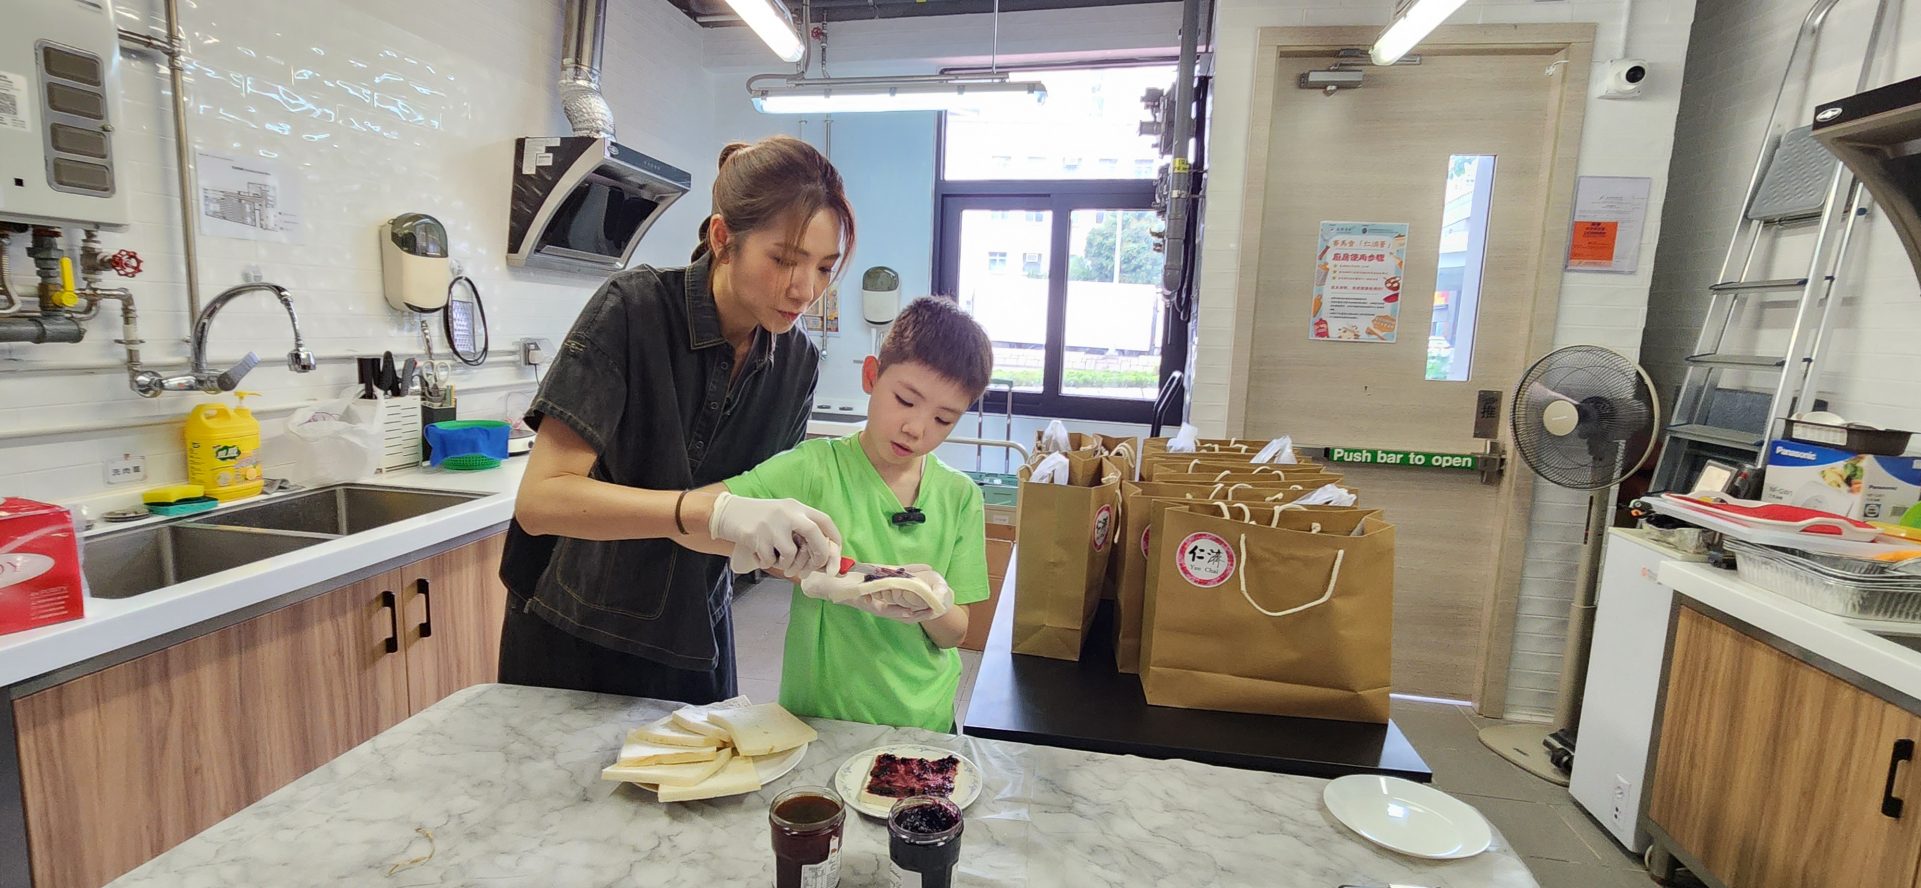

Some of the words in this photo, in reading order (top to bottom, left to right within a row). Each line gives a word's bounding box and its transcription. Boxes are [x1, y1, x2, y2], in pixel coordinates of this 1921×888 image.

[1333, 449, 1372, 463] Push
[1377, 450, 1403, 464] bar
[1409, 452, 1425, 465] to
[1431, 455, 1472, 468] open
[1775, 446, 1817, 460] Panasonic
